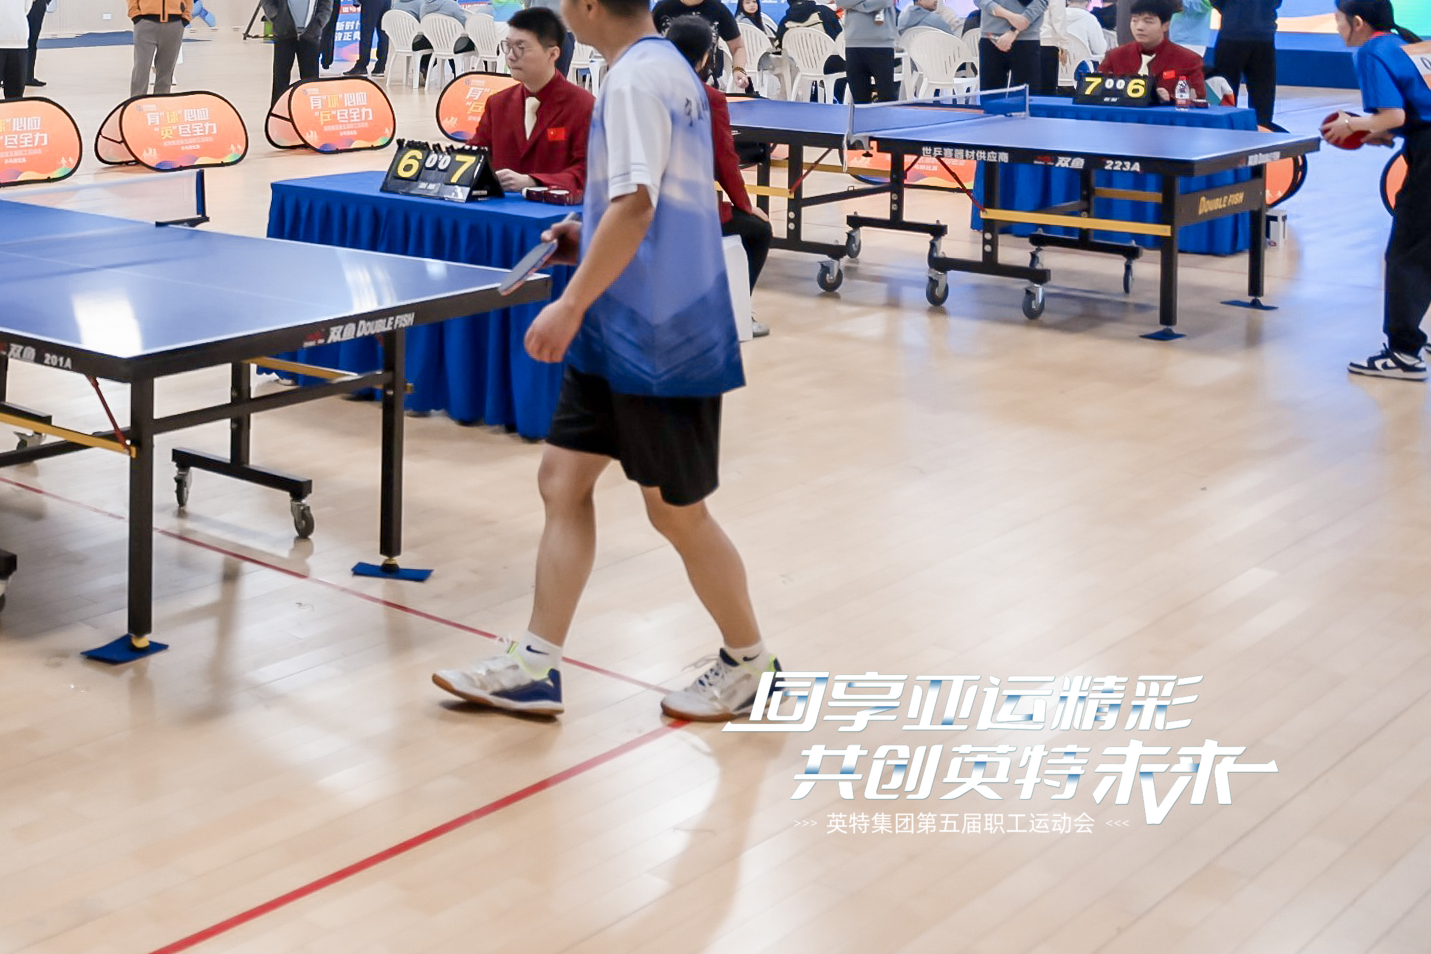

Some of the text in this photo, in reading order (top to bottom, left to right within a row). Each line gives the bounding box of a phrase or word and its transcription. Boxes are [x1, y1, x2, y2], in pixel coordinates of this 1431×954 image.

[1085, 77, 1146, 98] 7 0 0 6
[922, 146, 1009, 163] 世乒赛器材供应商
[1055, 156, 1085, 169] 双鱼
[397, 149, 476, 184] 6 0 0 7
[1104, 159, 1141, 172] 223A
[327, 322, 357, 344] 双鱼
[8, 343, 37, 363] 双鱼
[43, 352, 73, 370] 201A
